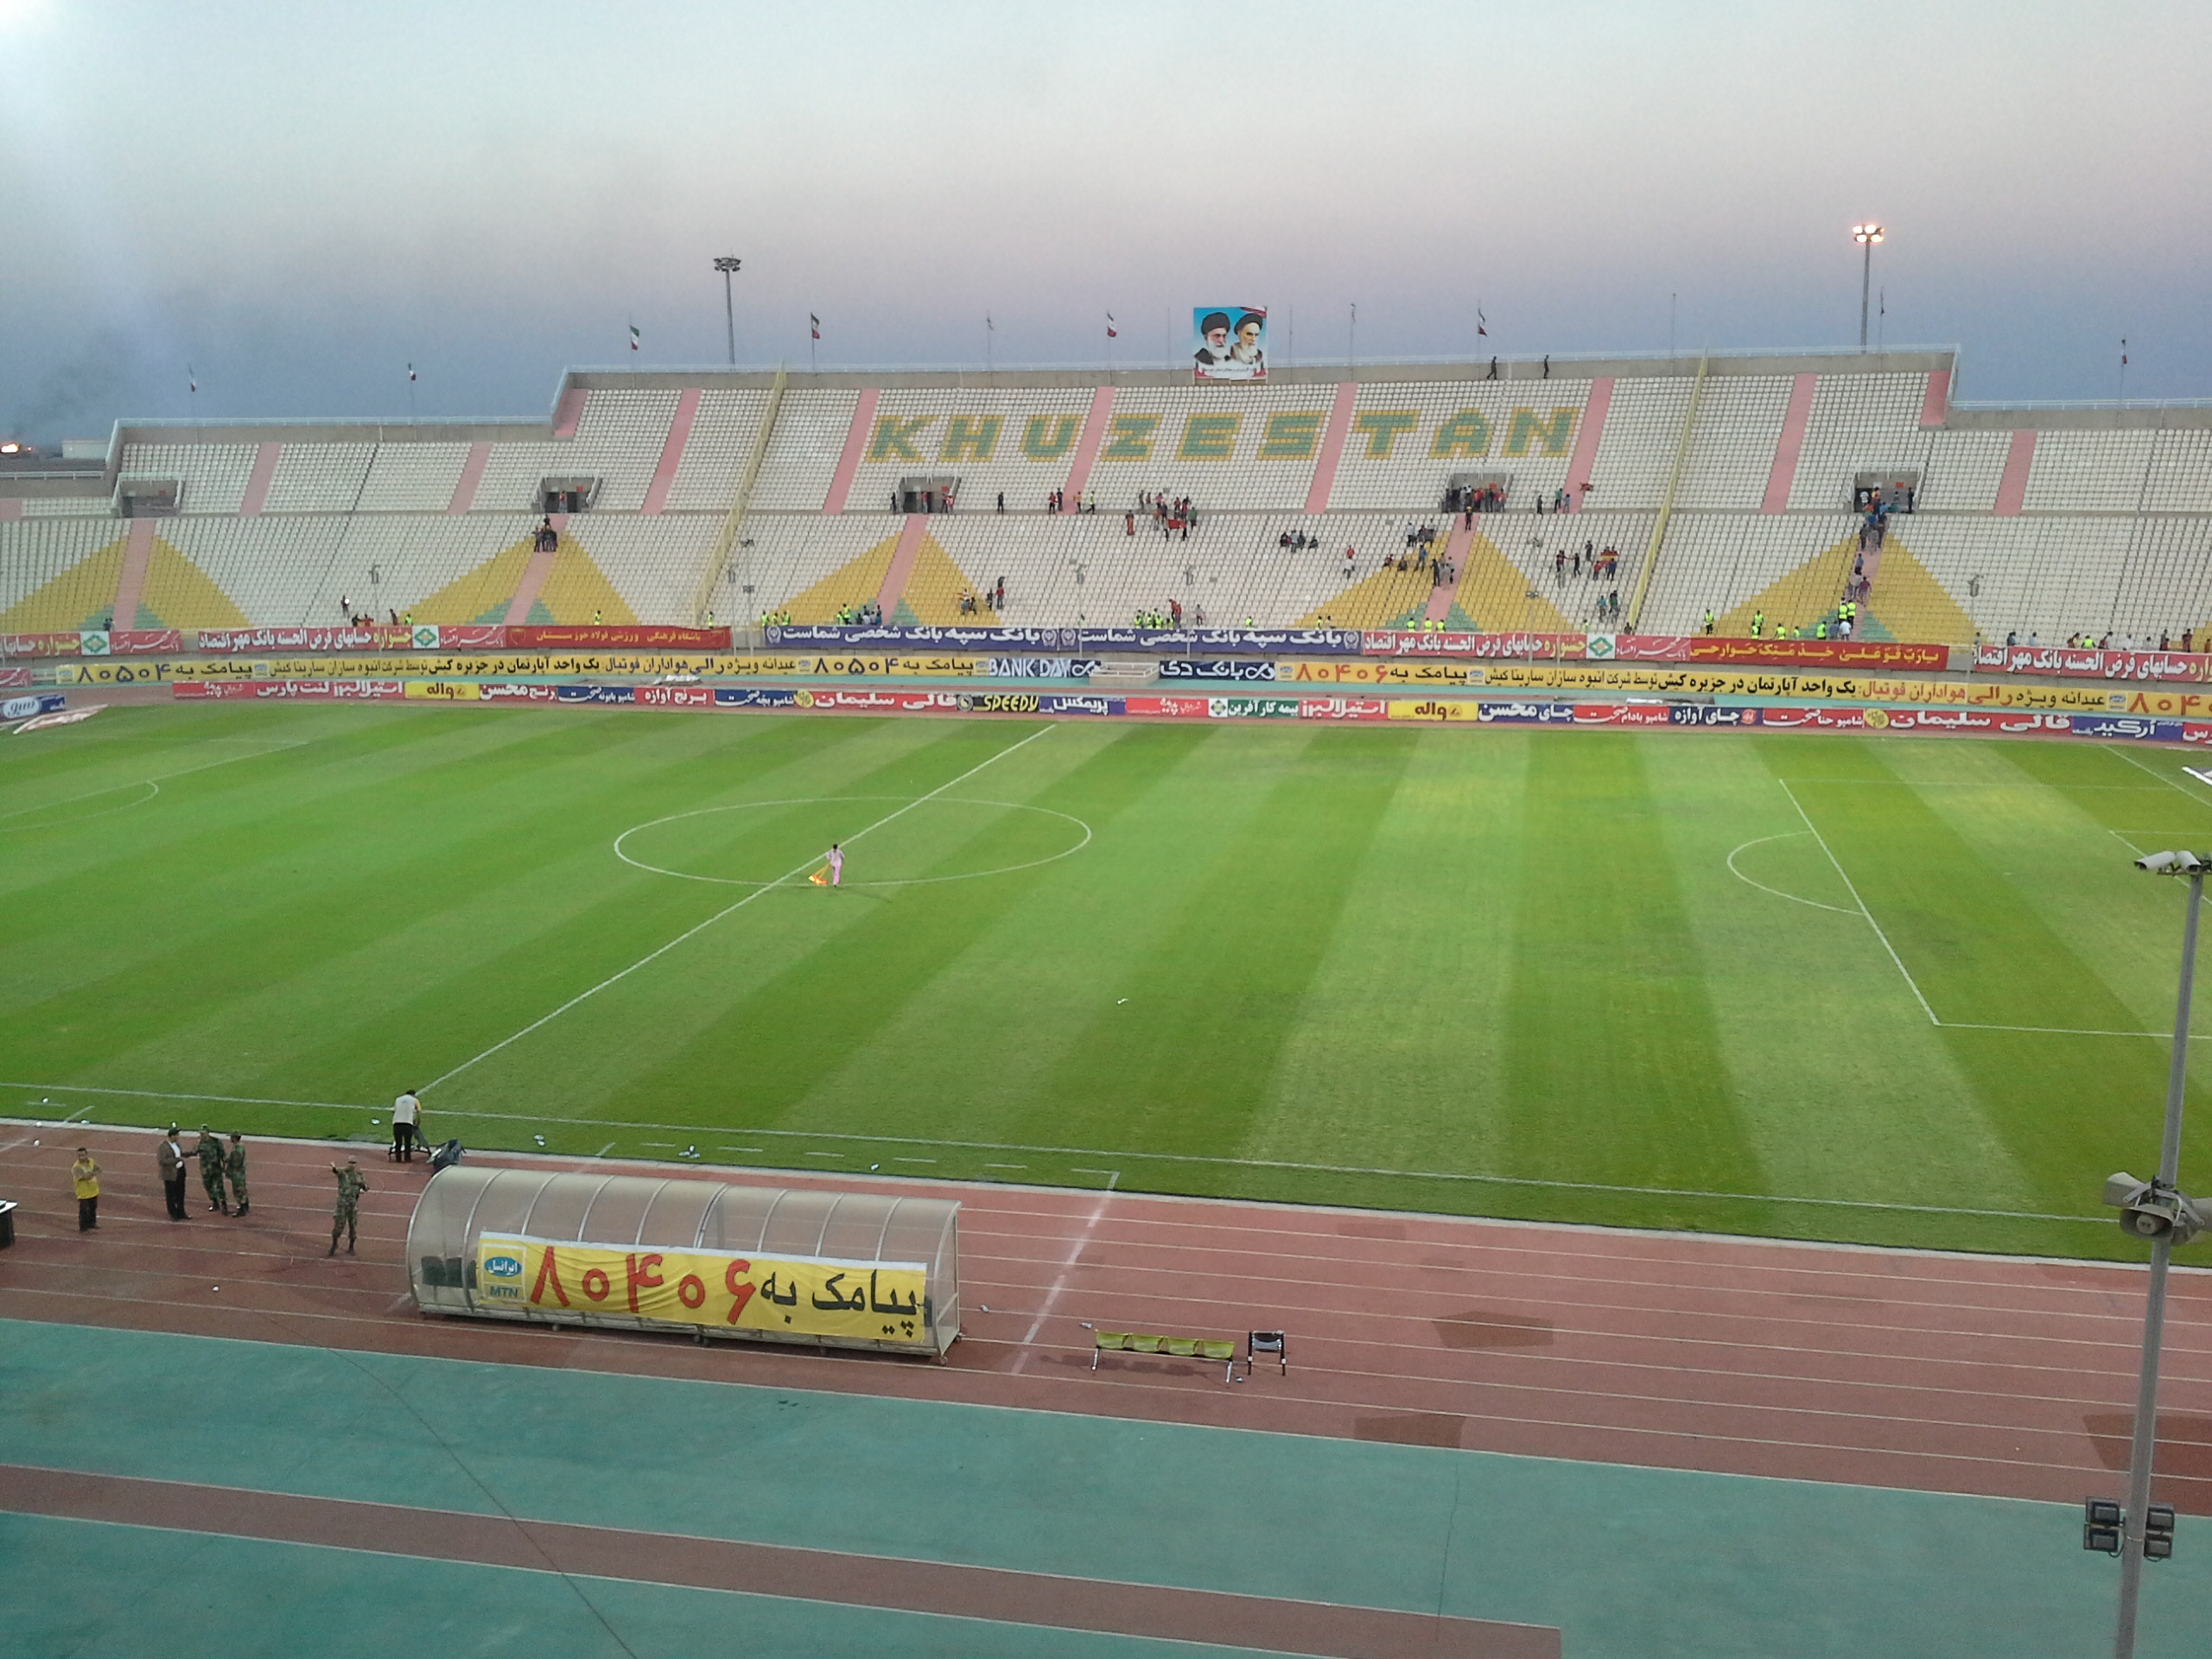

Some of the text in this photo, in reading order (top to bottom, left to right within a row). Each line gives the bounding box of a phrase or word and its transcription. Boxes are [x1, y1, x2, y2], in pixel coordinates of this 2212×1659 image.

[865, 407, 1580, 463] KHUZESTAN
[782, 626, 1041, 646] بانک سپه بانک شخصی شماست
[1201, 630, 1242, 648] بانک
[1242, 631, 1287, 650] سپه
[1289, 631, 1343, 649] بانک
[200, 661, 253, 681] پیامک
[429, 658, 454, 675] کیش
[456, 659, 489, 675] جزیره
[492, 659, 505, 675] در
[506, 657, 551, 675] آپارتمان
[553, 657, 581, 674] واحد
[902, 659, 920, 675] به
[925, 657, 974, 677] پیامک
[988, 658, 1038, 677] BANK
[1039, 658, 1072, 677] DAY
[1160, 660, 1244, 681] بانک دی
[2033, 650, 2063, 675] بانک
[175, 665, 195, 681] به
[1389, 666, 1409, 683] به
[1414, 665, 1467, 686] پیامک
[1484, 669, 1510, 686] کیش
[1657, 673, 1688, 690] کیش
[1689, 676, 1726, 694] جزیره
[1728, 677, 1744, 695] در
[1746, 676, 1799, 697] آپارتمان
[1801, 678, 1833, 698] واحد
[1836, 680, 1856, 698] یک
[814, 691, 896, 709] سلیمان
[982, 695, 1039, 712] SPEEDY
[1478, 703, 1537, 722] محسن
[1890, 710, 1991, 729] سلیمان
[486, 1259, 518, 1276] ایرانسل
[489, 1286, 518, 1297] MTN
[760, 1271, 798, 1325] به
[812, 1268, 917, 1338] پیامک
